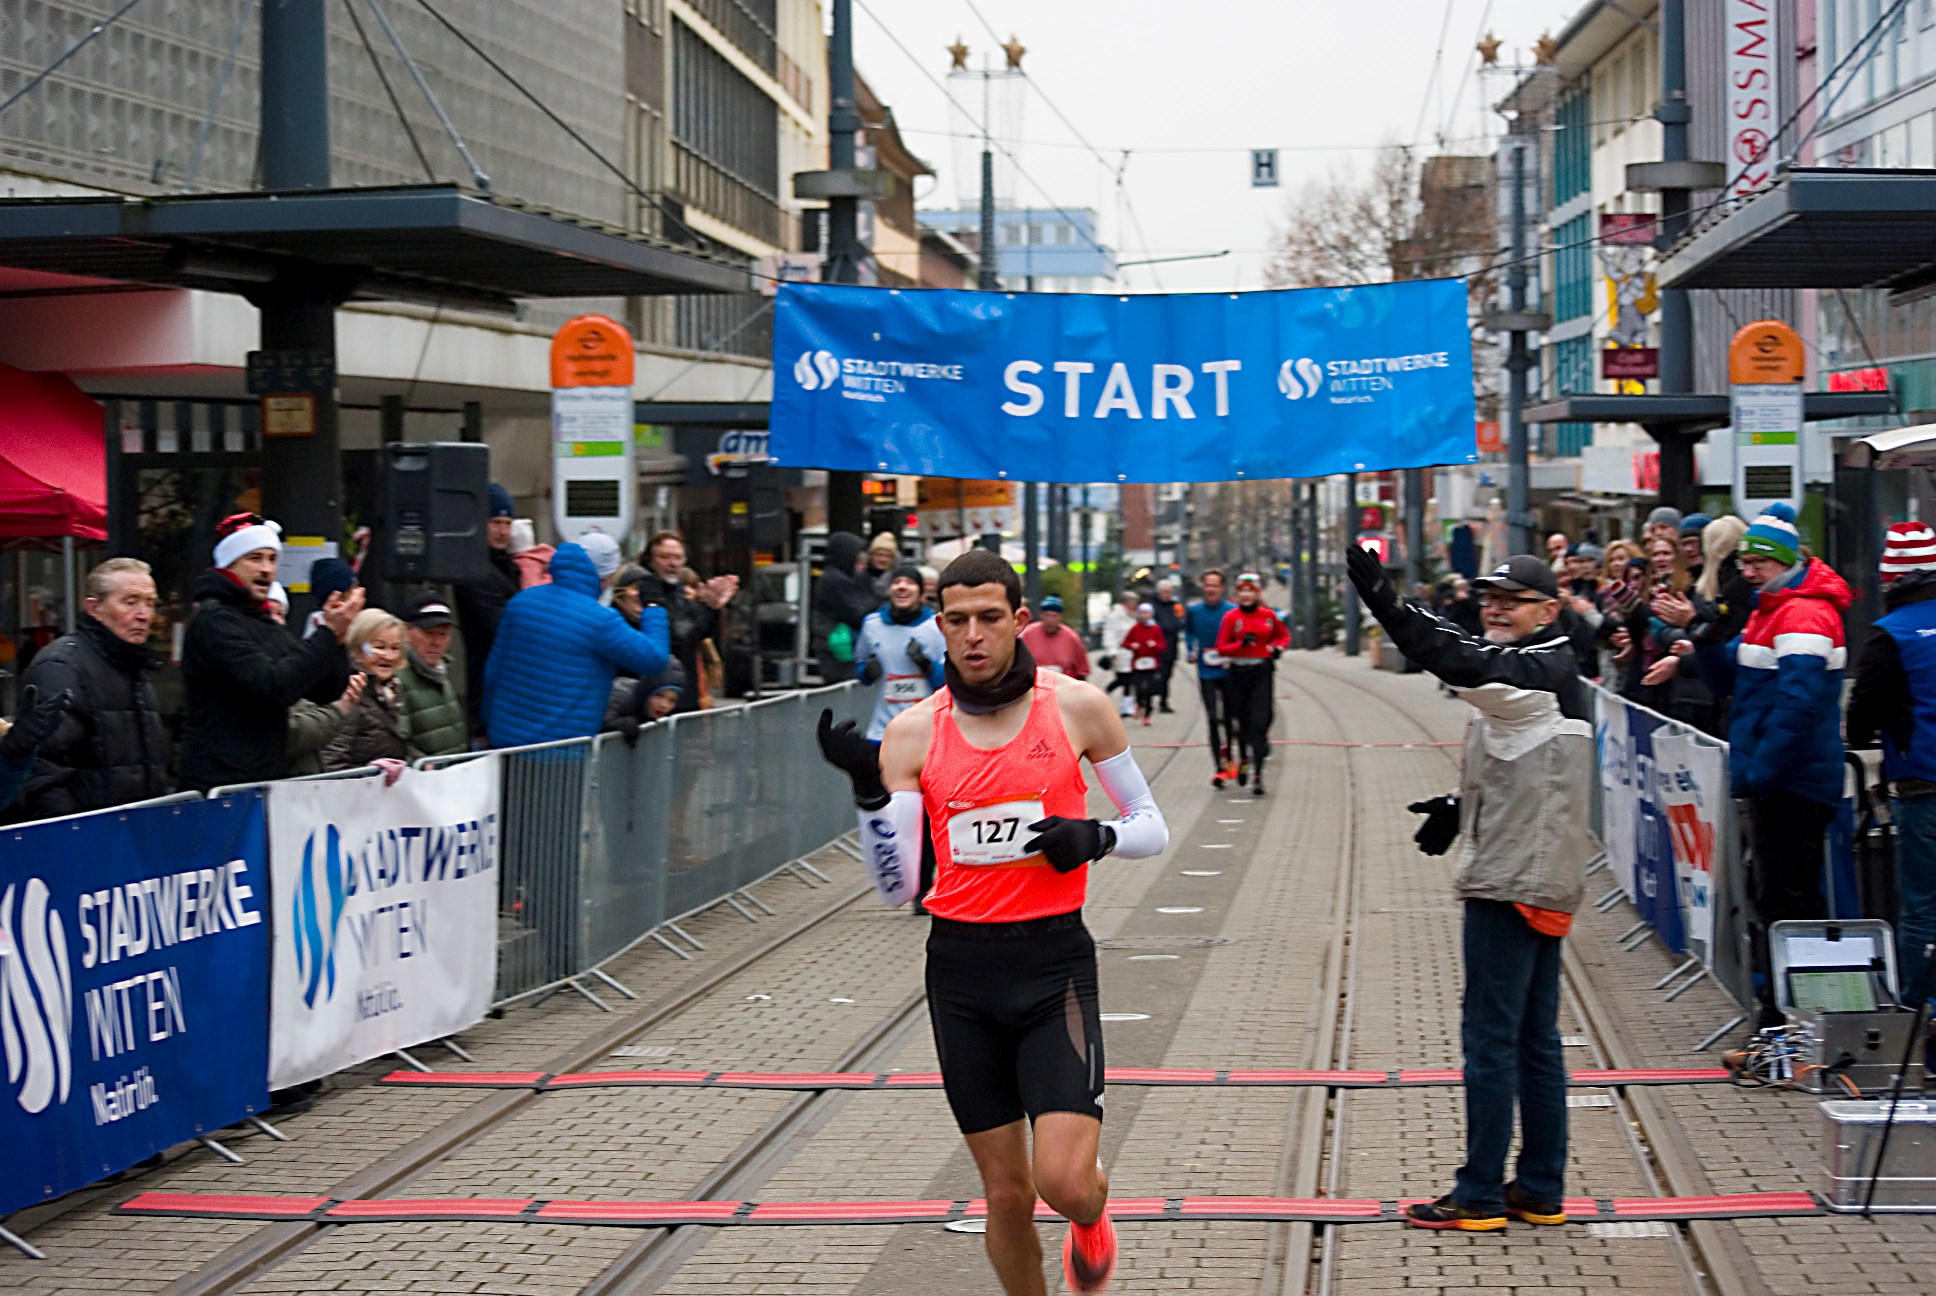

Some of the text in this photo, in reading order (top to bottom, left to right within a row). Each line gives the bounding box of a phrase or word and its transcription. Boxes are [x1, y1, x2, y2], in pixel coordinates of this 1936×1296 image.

[1254, 151, 1275, 178] H
[841, 357, 963, 381] STADTWERKE
[1325, 351, 1450, 376] STADTWERKE
[1000, 359, 1243, 420] START
[1328, 376, 1394, 393] WITTEN
[972, 817, 1020, 845] 127
[78, 859, 263, 969] STADTWERKE
